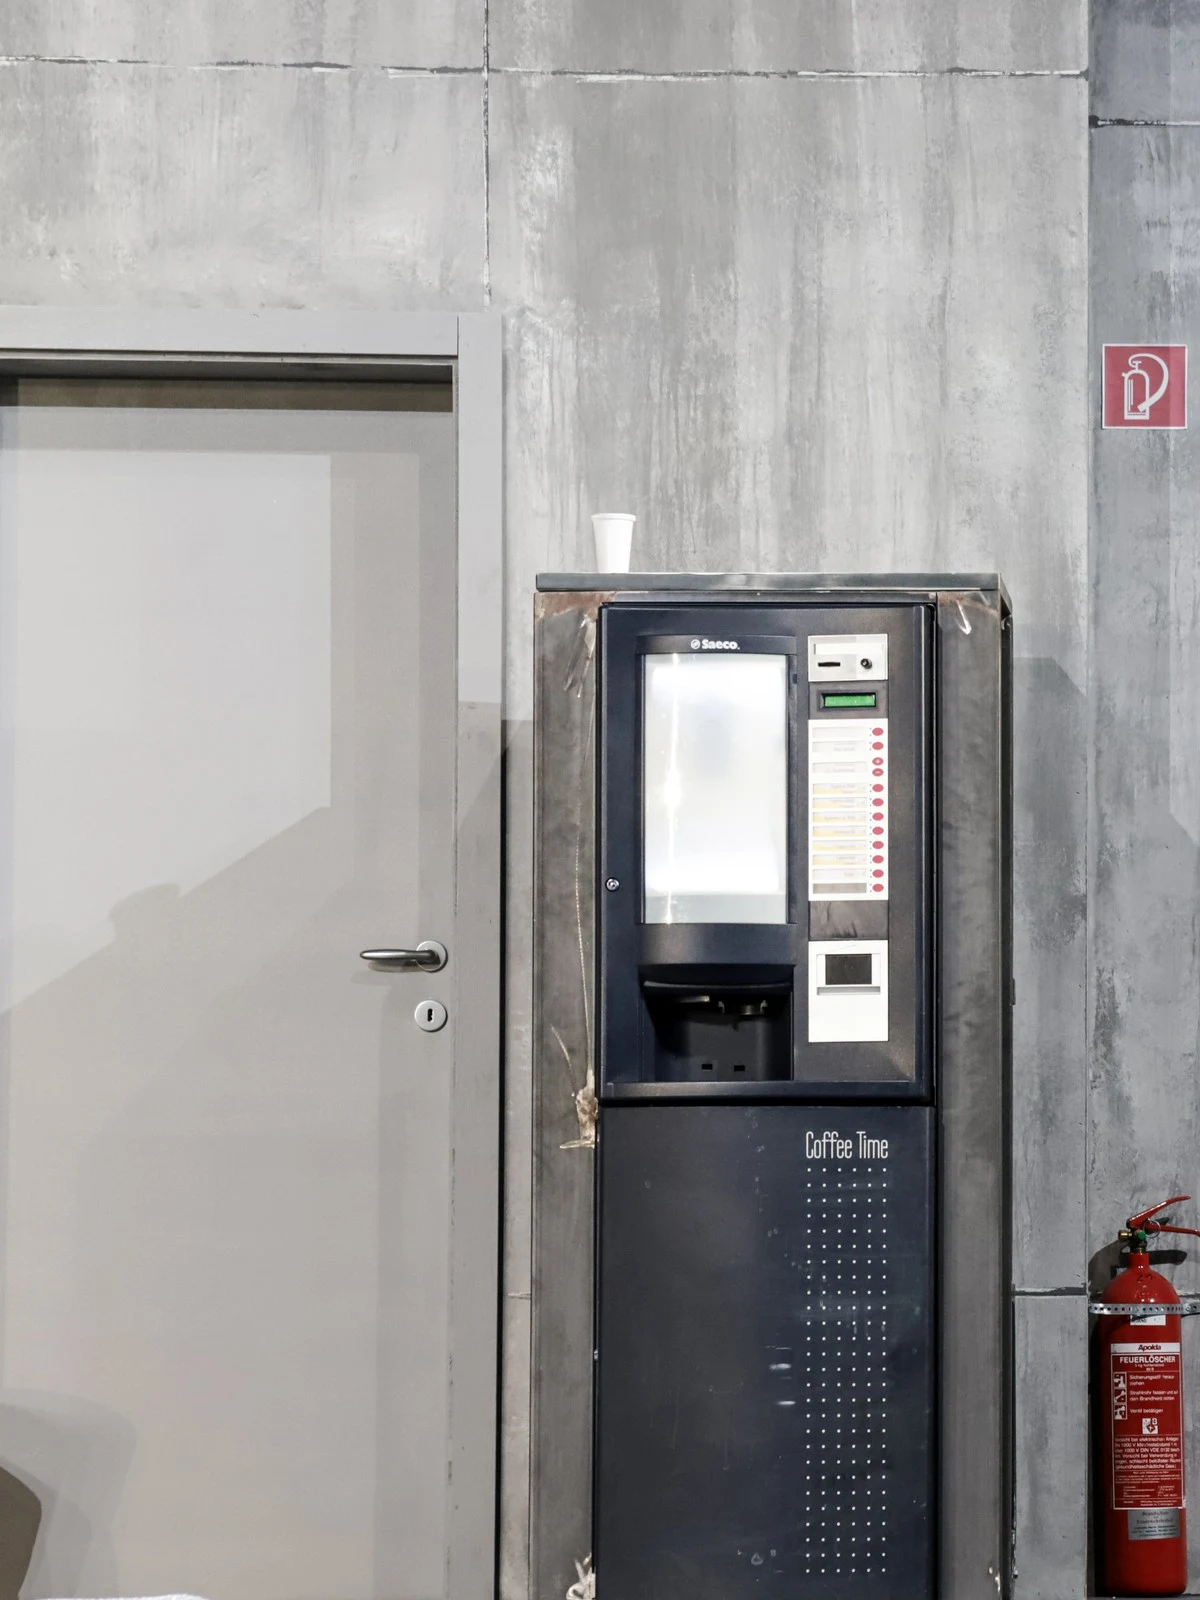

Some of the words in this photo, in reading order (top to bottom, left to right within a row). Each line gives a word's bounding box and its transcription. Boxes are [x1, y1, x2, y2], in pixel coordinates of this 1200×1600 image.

[806, 1131, 852, 1159] Coffee
[856, 1131, 888, 1159] Time
[1138, 1344, 1162, 1352] Apolda
[1120, 1354, 1176, 1364] FEUERLÖSCHER
